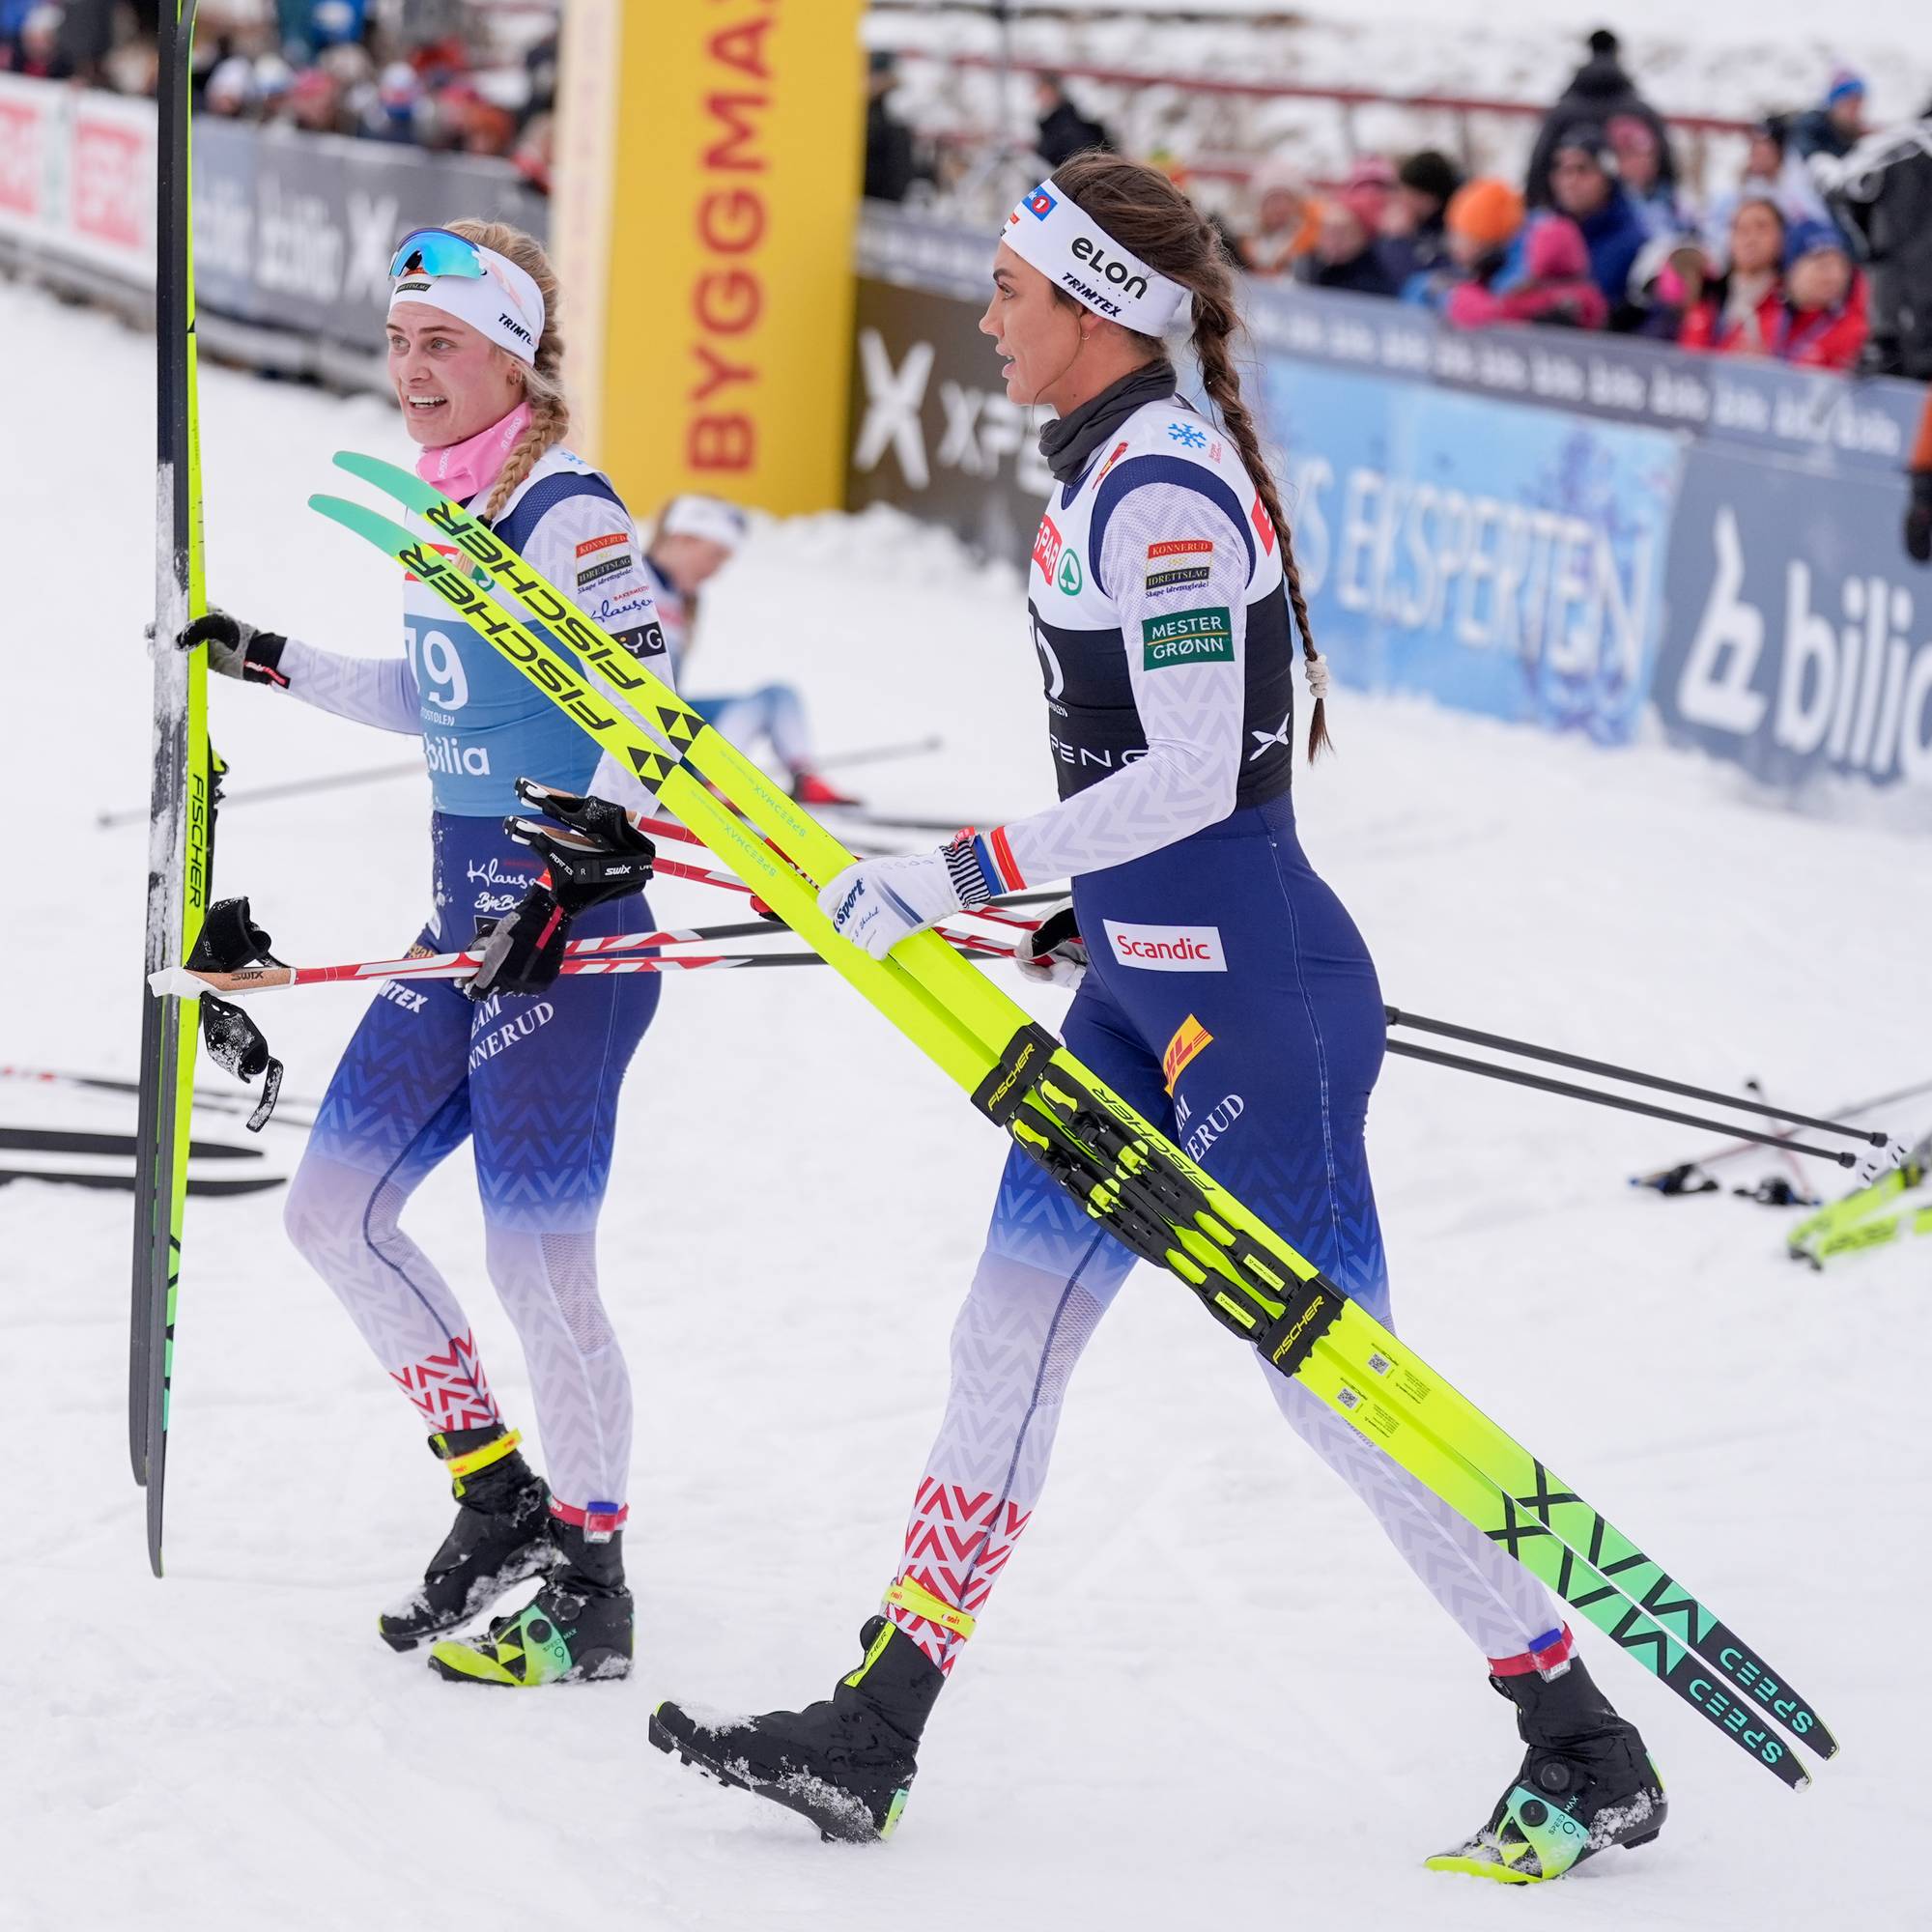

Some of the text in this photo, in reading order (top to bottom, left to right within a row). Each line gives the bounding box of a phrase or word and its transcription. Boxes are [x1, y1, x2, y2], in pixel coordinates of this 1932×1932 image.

[684, 0, 781, 474] BYGGMA
[1062, 271, 1122, 318] TRIMTEX
[497, 312, 534, 348] TRIMTE
[579, 557, 631, 582] IDRETTSLAG
[1148, 569, 1208, 586] IDRETTSLAG
[1151, 543, 1208, 556] KONNERUD
[1337, 466, 1651, 686] EKSPERTEN
[426, 500, 645, 690] FISCHER
[1151, 615, 1223, 640] MESTER
[399, 542, 618, 731] FISCHER
[1153, 638, 1224, 660] GRØNN
[422, 732, 491, 777] bilia
[188, 773, 205, 909] FISCHER
[1117, 935, 1211, 961] Scandic
[987, 1042, 1036, 1112] FISCHER
[1092, 1087, 1216, 1192] FISCHER
[1271, 1294, 1325, 1365] FISCHER
[1690, 1678, 1783, 1765] SPEED
[1719, 1647, 1814, 1734] SPEED
